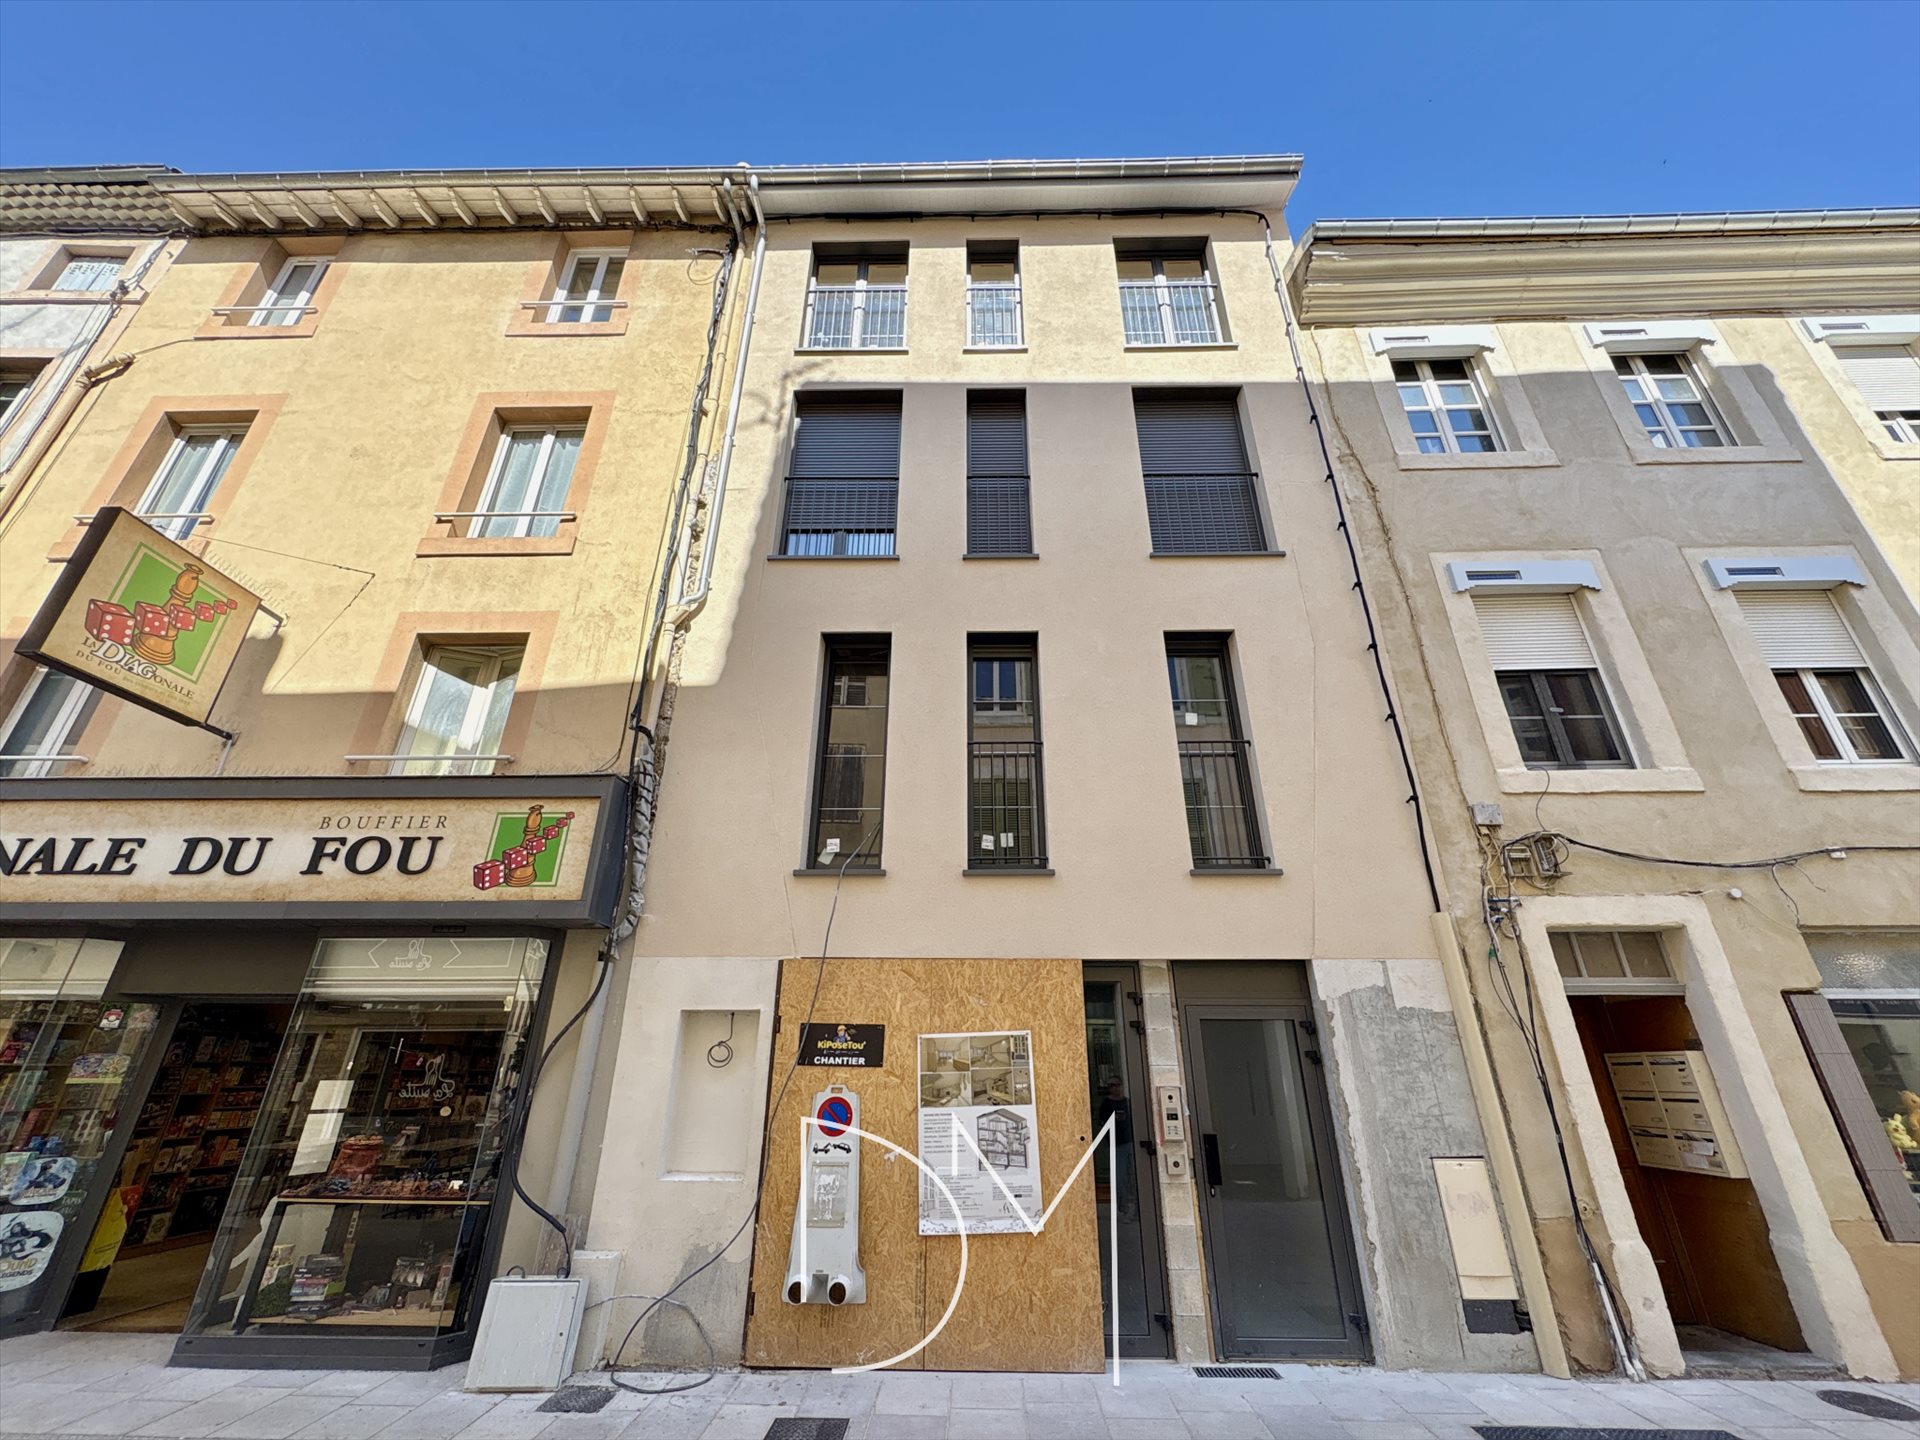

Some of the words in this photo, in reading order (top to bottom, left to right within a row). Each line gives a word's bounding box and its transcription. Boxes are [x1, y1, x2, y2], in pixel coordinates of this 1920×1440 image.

[76, 650, 94, 662] DU
[97, 660, 122, 675] FOU
[81, 636, 97, 649] LA
[90, 637, 196, 700] DIAGONALE
[318, 815, 448, 830] BOUFFIER
[168, 836, 274, 876] DU
[299, 835, 444, 876] FOU
[813, 1056, 866, 1066] CHANTIER
